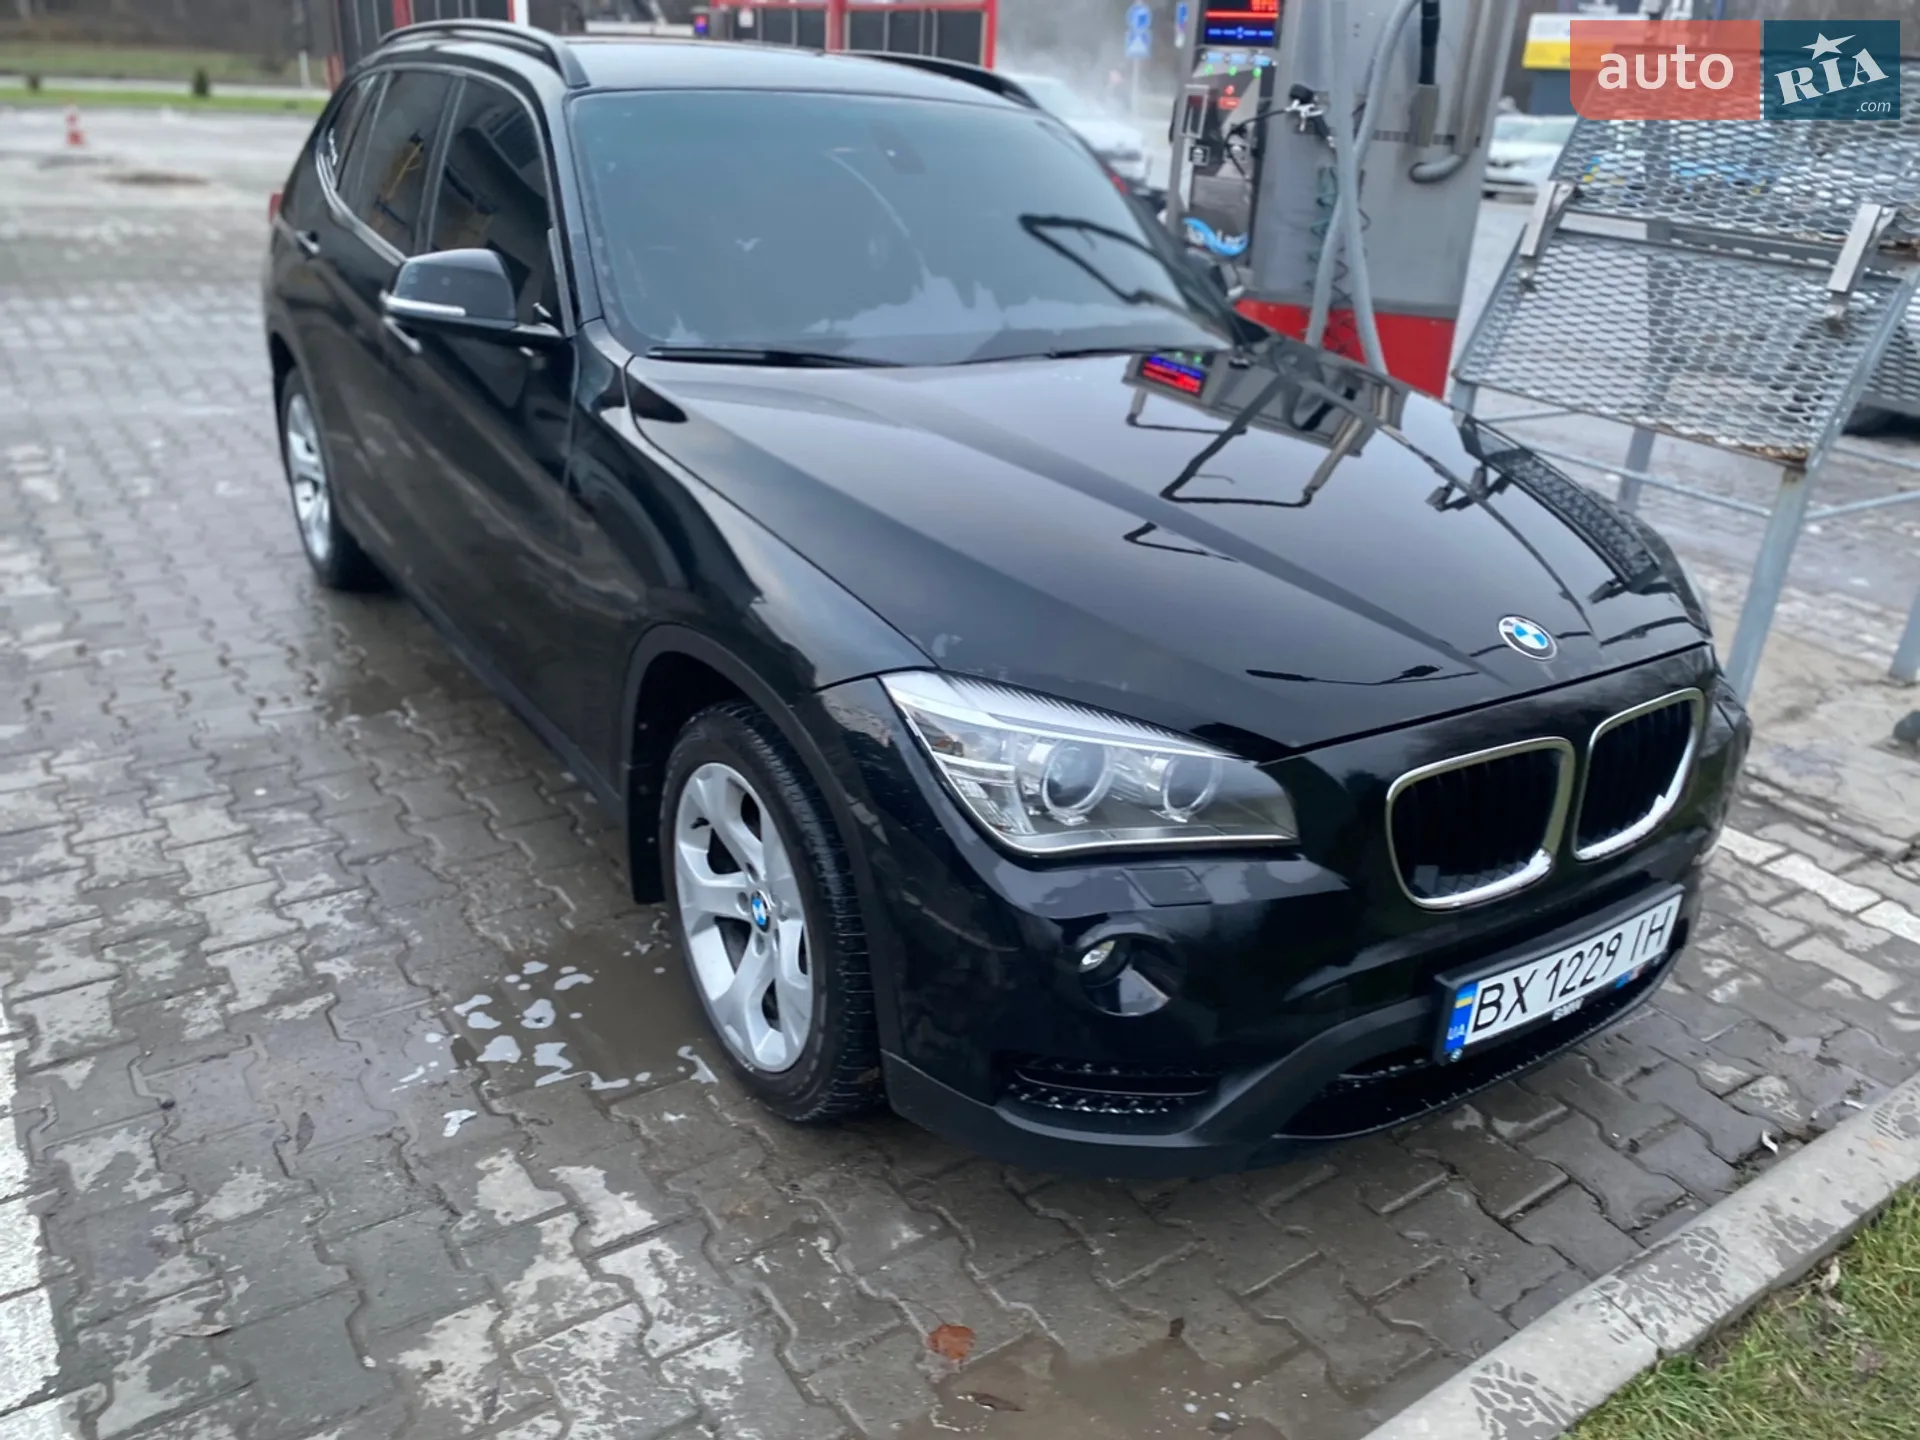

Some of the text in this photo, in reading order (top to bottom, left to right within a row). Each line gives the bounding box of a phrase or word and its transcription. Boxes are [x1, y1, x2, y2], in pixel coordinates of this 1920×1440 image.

[1472, 906, 1673, 1033] BX 1229 IH
